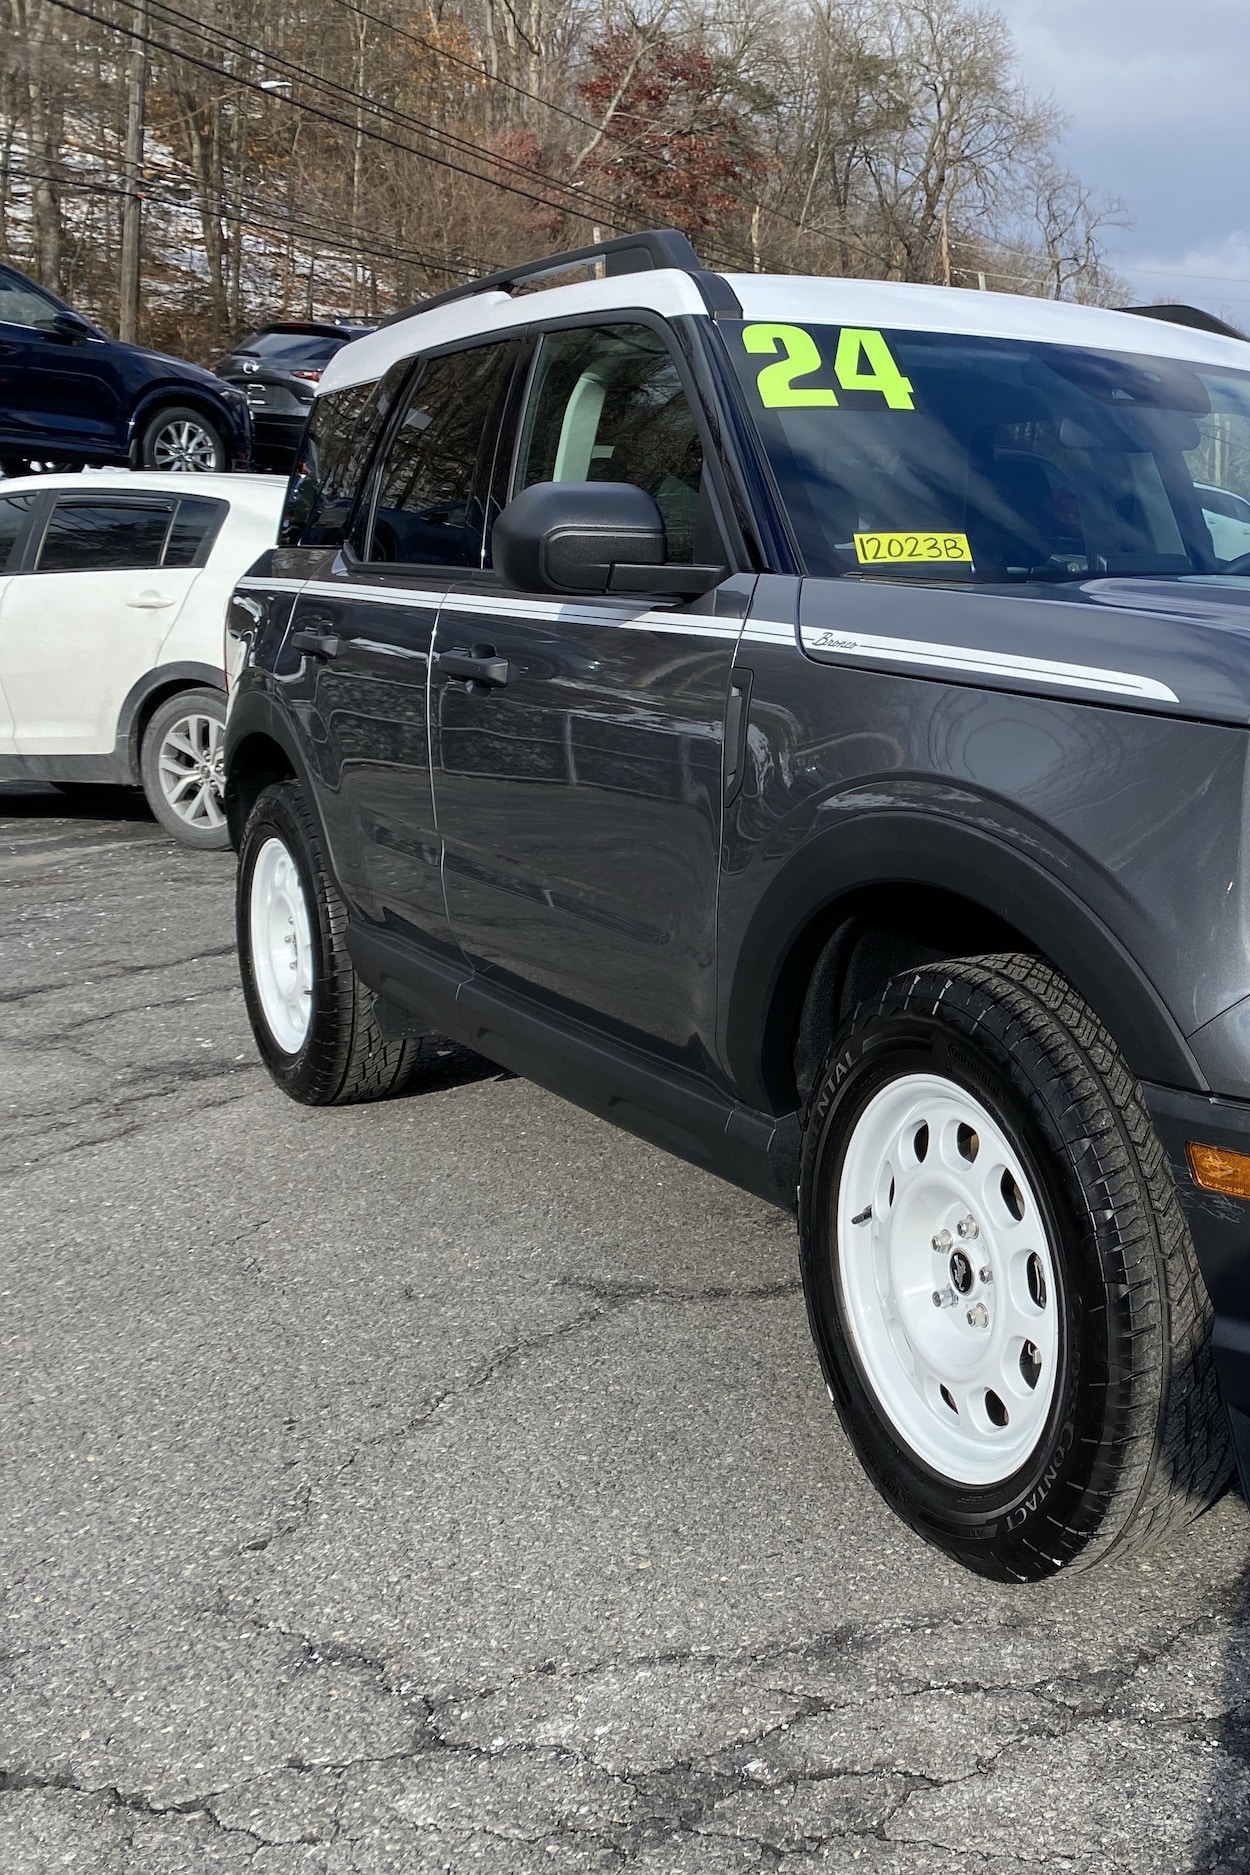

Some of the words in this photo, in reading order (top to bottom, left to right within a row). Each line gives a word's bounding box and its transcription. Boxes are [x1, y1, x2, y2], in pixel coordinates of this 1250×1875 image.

[742, 323, 915, 410] 24
[859, 536, 964, 561] 12023B
[813, 631, 857, 650] Bronco
